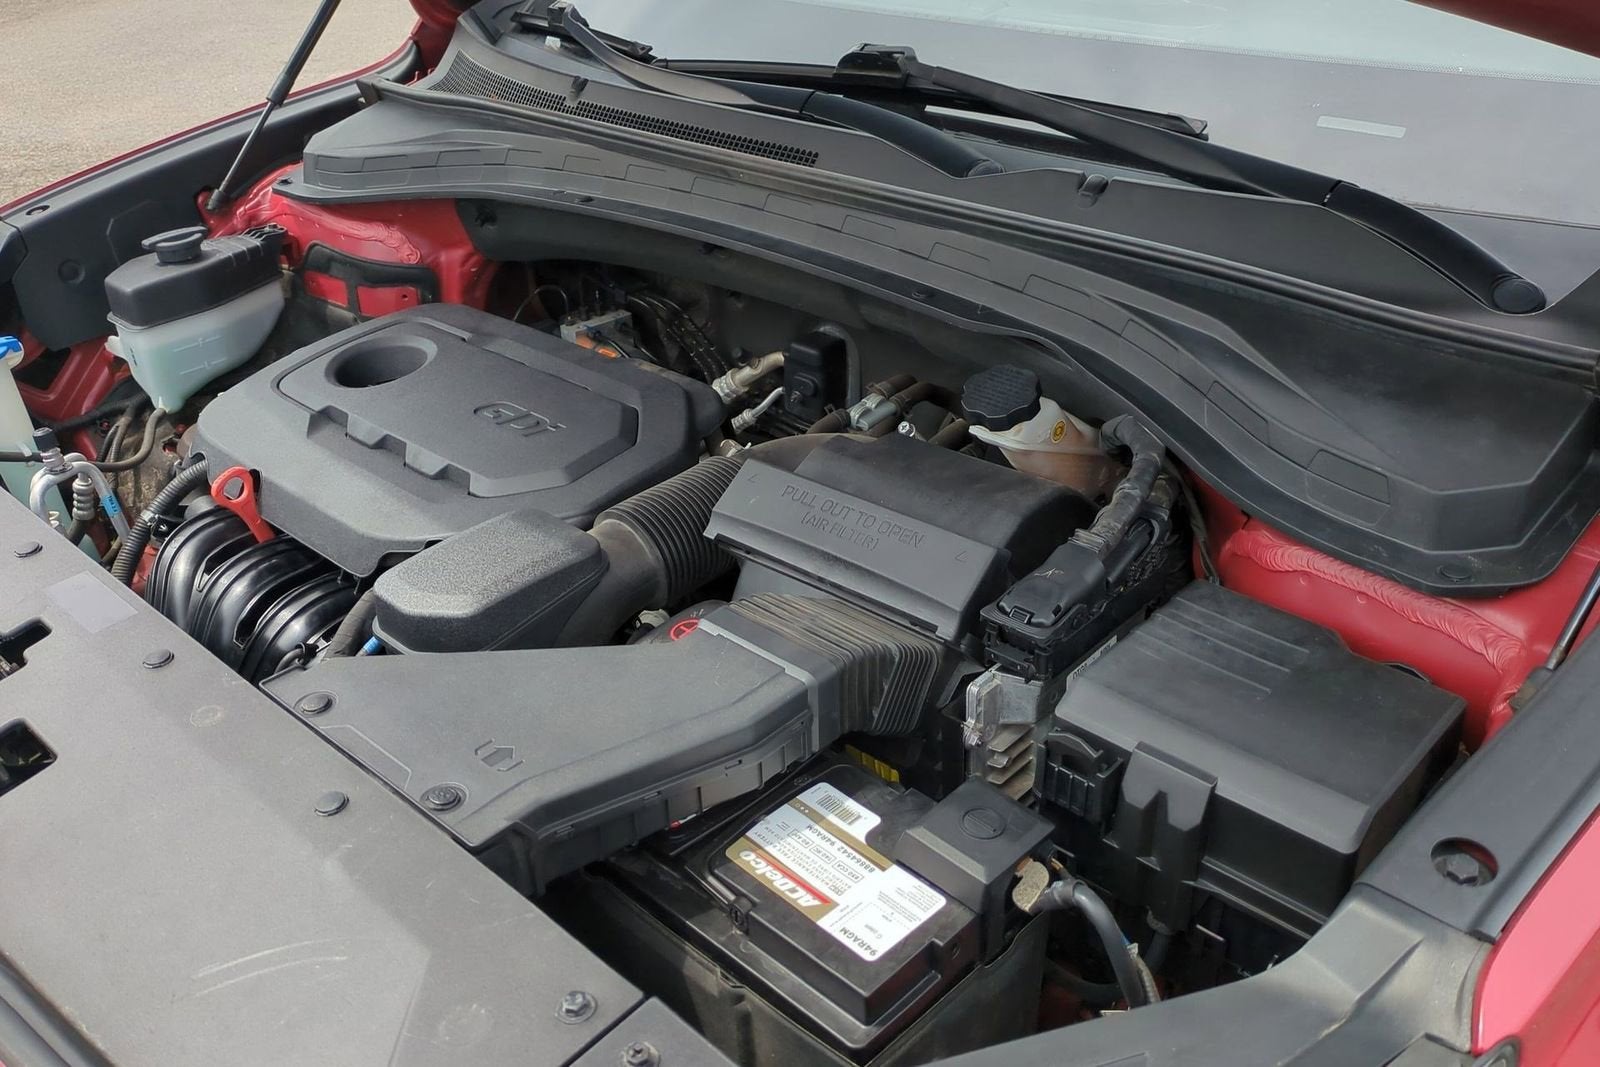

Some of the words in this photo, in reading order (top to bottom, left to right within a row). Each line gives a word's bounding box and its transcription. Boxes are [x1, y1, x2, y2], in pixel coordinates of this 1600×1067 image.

[781, 484, 817, 508] PULL
[820, 499, 856, 521] OUT
[856, 510, 877, 529] TO
[877, 519, 925, 549] OPEN
[800, 511, 830, 532] (AIR
[829, 522, 879, 552] FILTER)
[804, 823, 837, 846] 94RAGM
[835, 844, 876, 873] 88864542
[835, 862, 849, 873] CCA
[738, 849, 822, 908] ACDelco
[838, 926, 878, 957] 94RAGM
